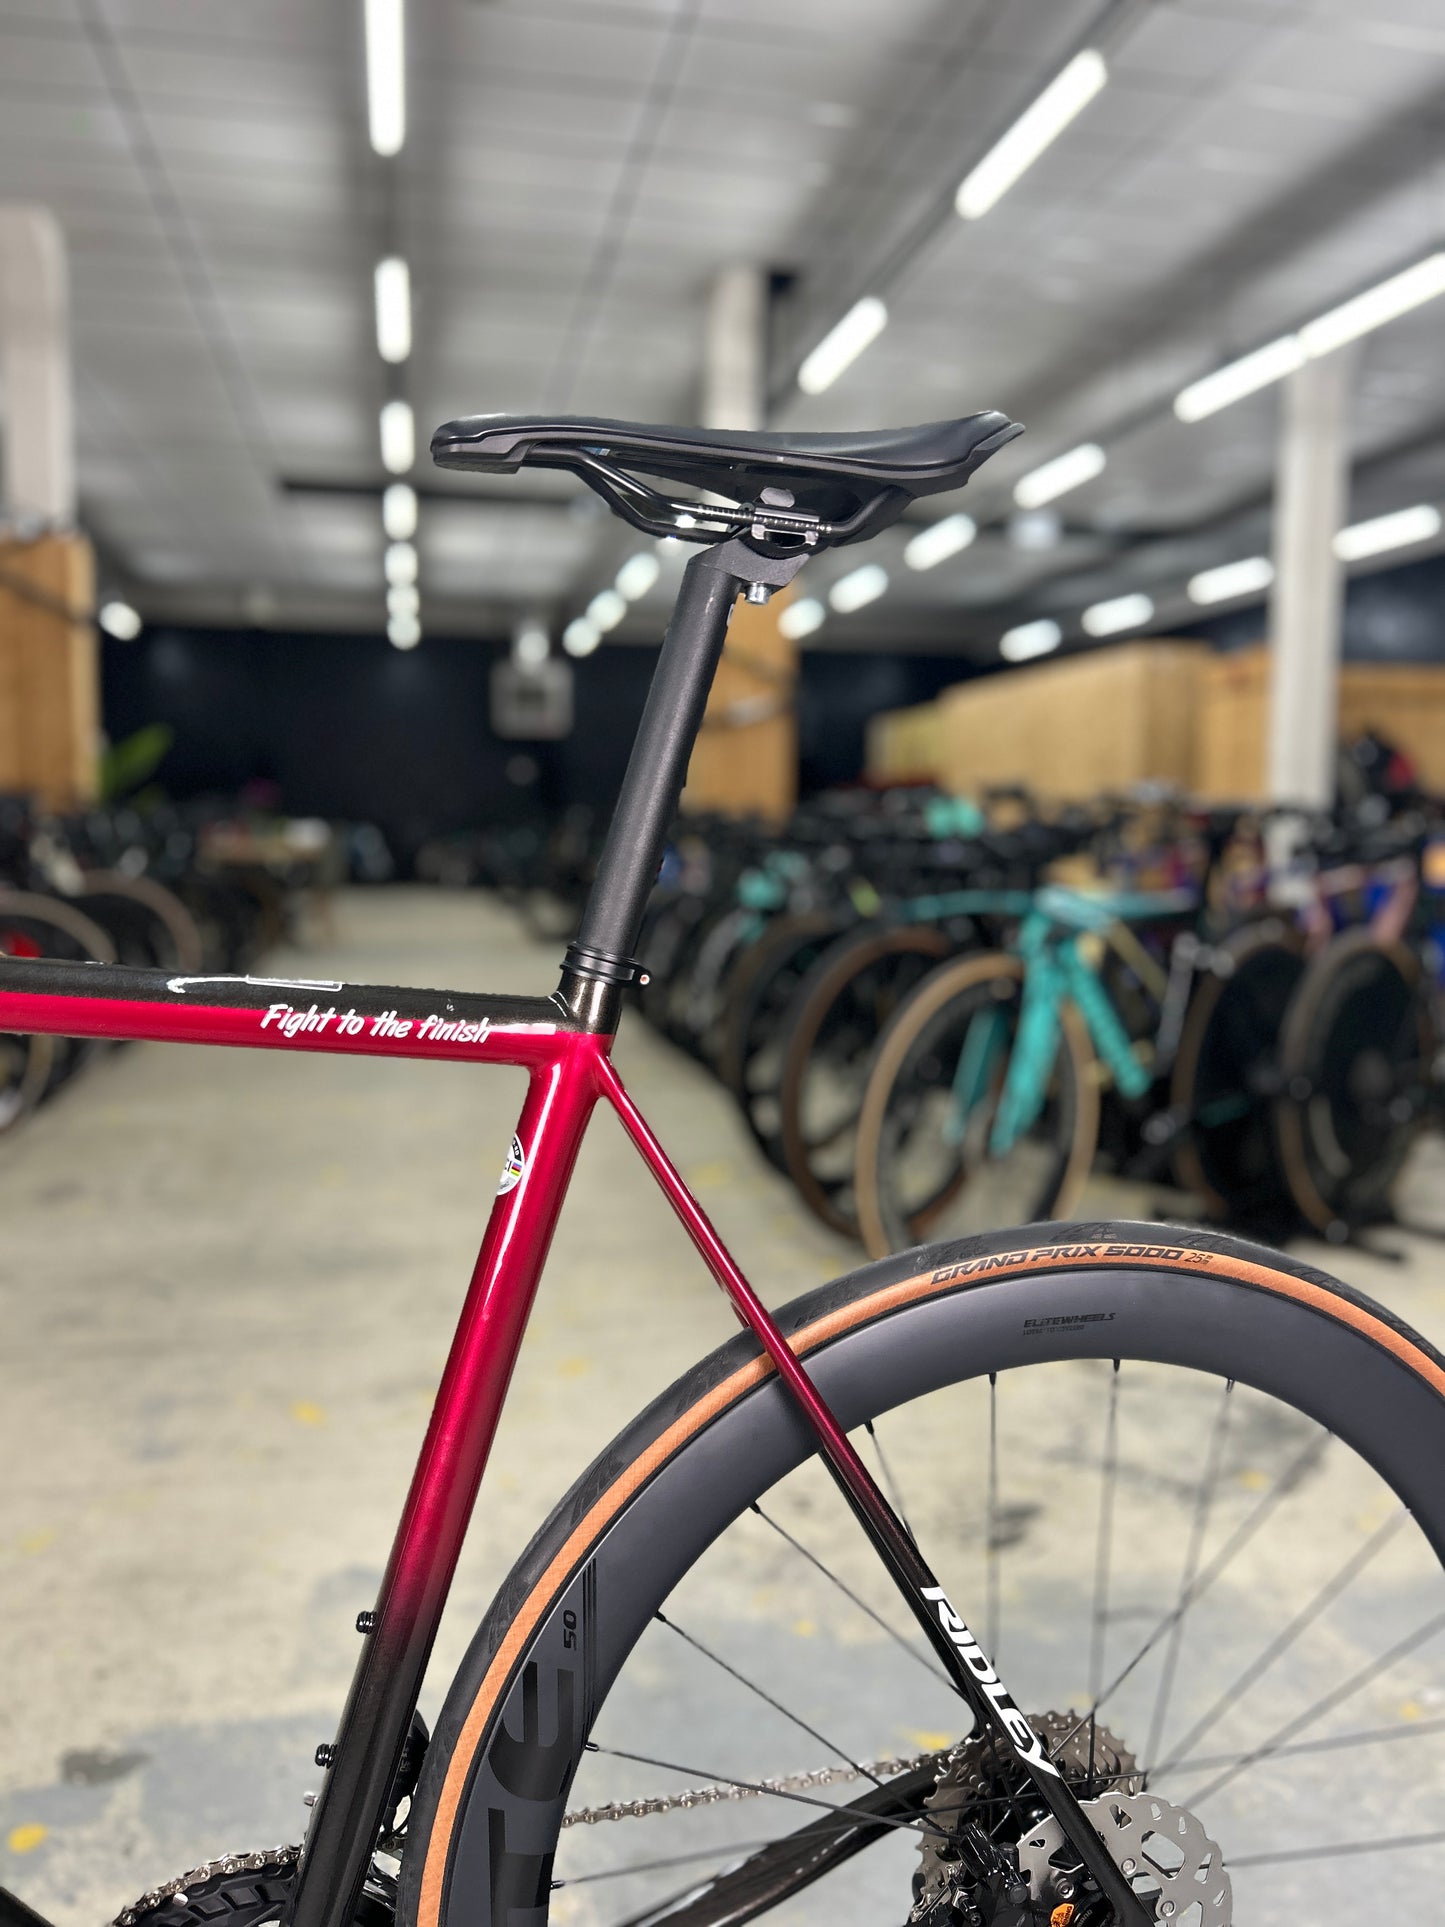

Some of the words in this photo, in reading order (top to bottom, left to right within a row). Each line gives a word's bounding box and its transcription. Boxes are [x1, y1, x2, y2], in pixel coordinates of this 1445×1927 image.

[260, 1003, 336, 1038] Fight
[336, 1008, 365, 1035] to
[369, 1010, 413, 1039] the
[416, 1014, 491, 1043] finish
[931, 1252, 1029, 1285] GRAND
[1031, 1245, 1102, 1262] PRIX
[1103, 1245, 1184, 1261] 5000
[563, 1609, 577, 1651] 50
[920, 1586, 1061, 1778] RIDLEY
